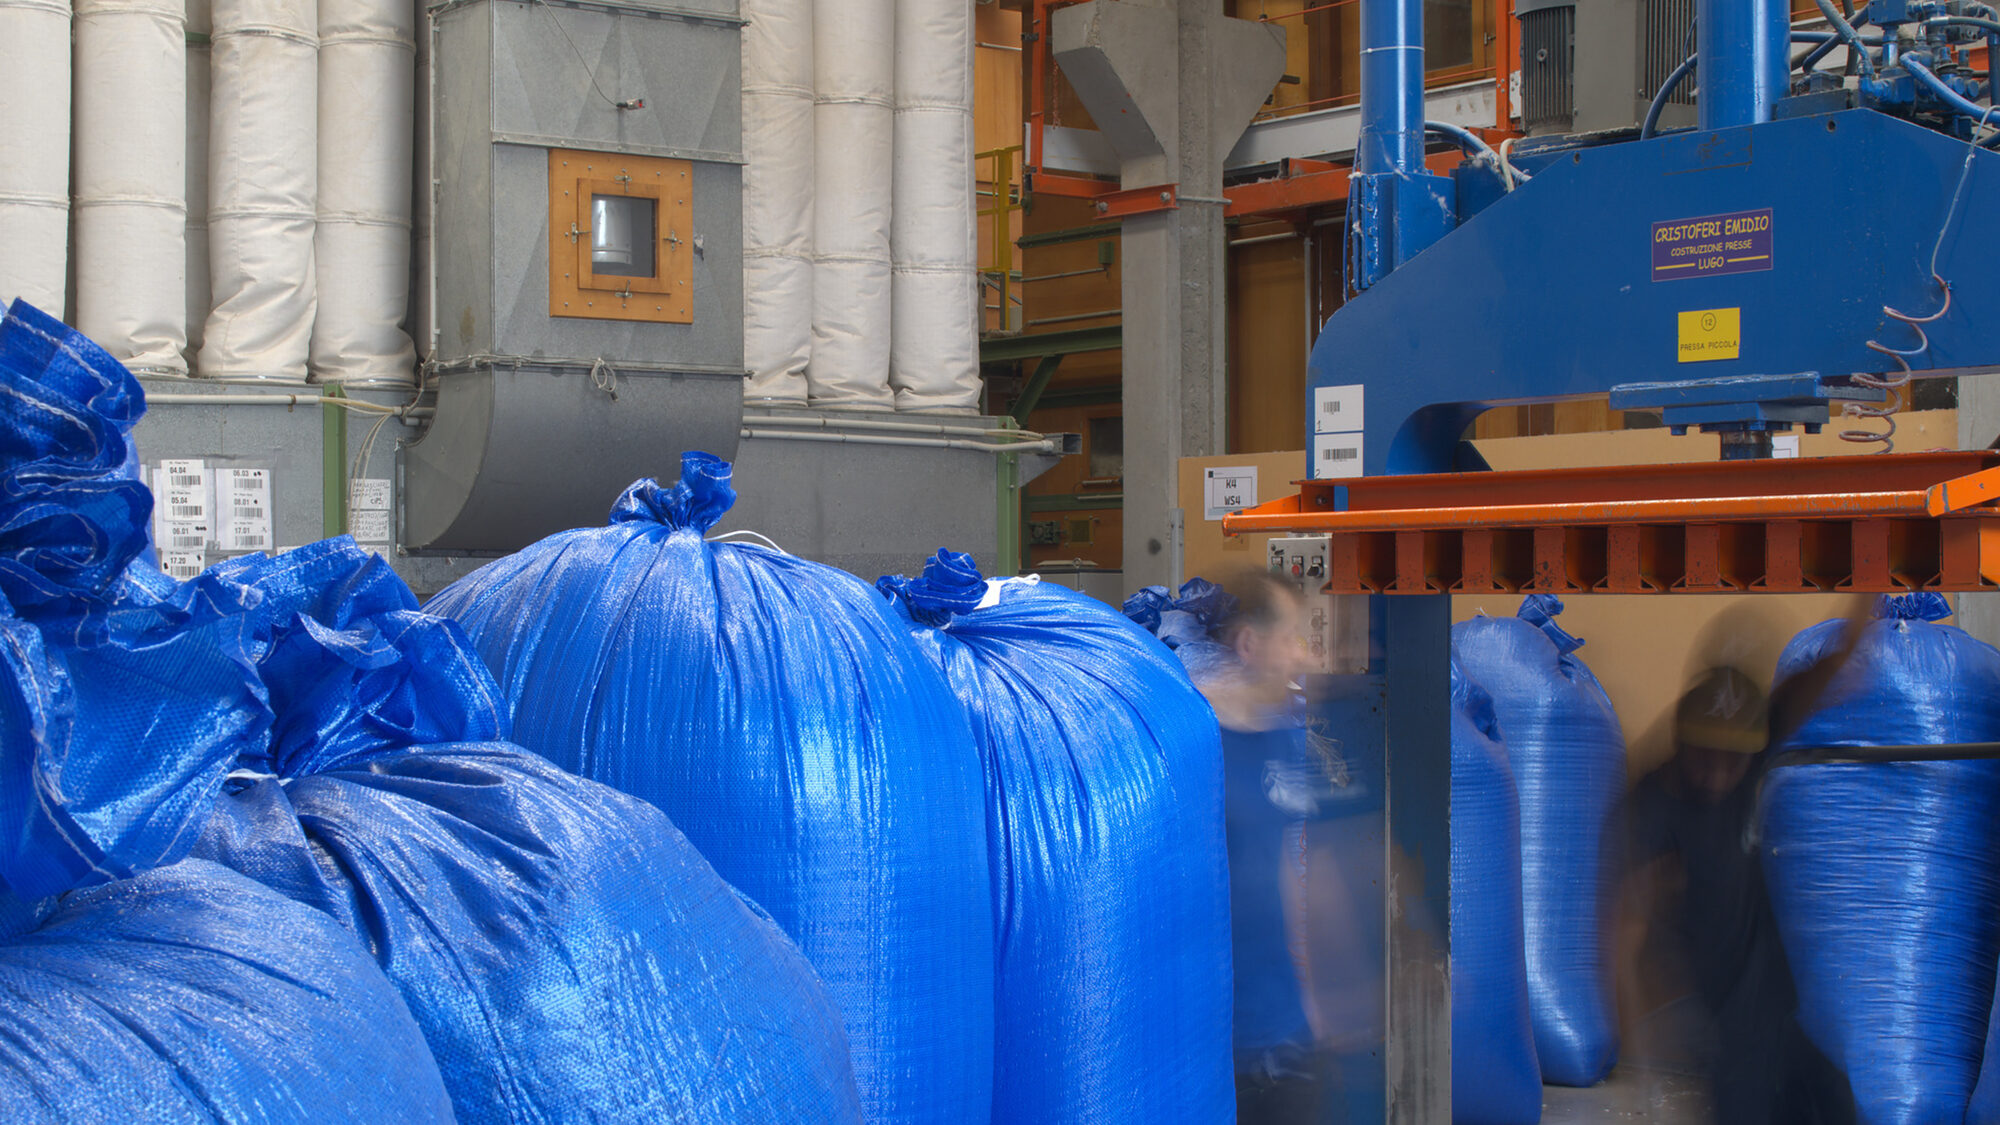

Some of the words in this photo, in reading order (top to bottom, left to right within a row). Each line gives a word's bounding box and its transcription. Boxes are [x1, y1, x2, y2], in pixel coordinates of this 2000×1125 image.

[1655, 221, 1721, 242] CRISTOFERI
[1725, 215, 1769, 235] EMIDIO
[1670, 242, 1723, 256] COSTRUZIONE
[1725, 239, 1753, 250] PRESSE
[1698, 256, 1724, 269] LUGO
[1680, 343, 1705, 351] PRESSA
[1708, 340, 1737, 349] PICCOLA
[1225, 479, 1237, 489] K4
[1224, 495, 1241, 506] WS4
